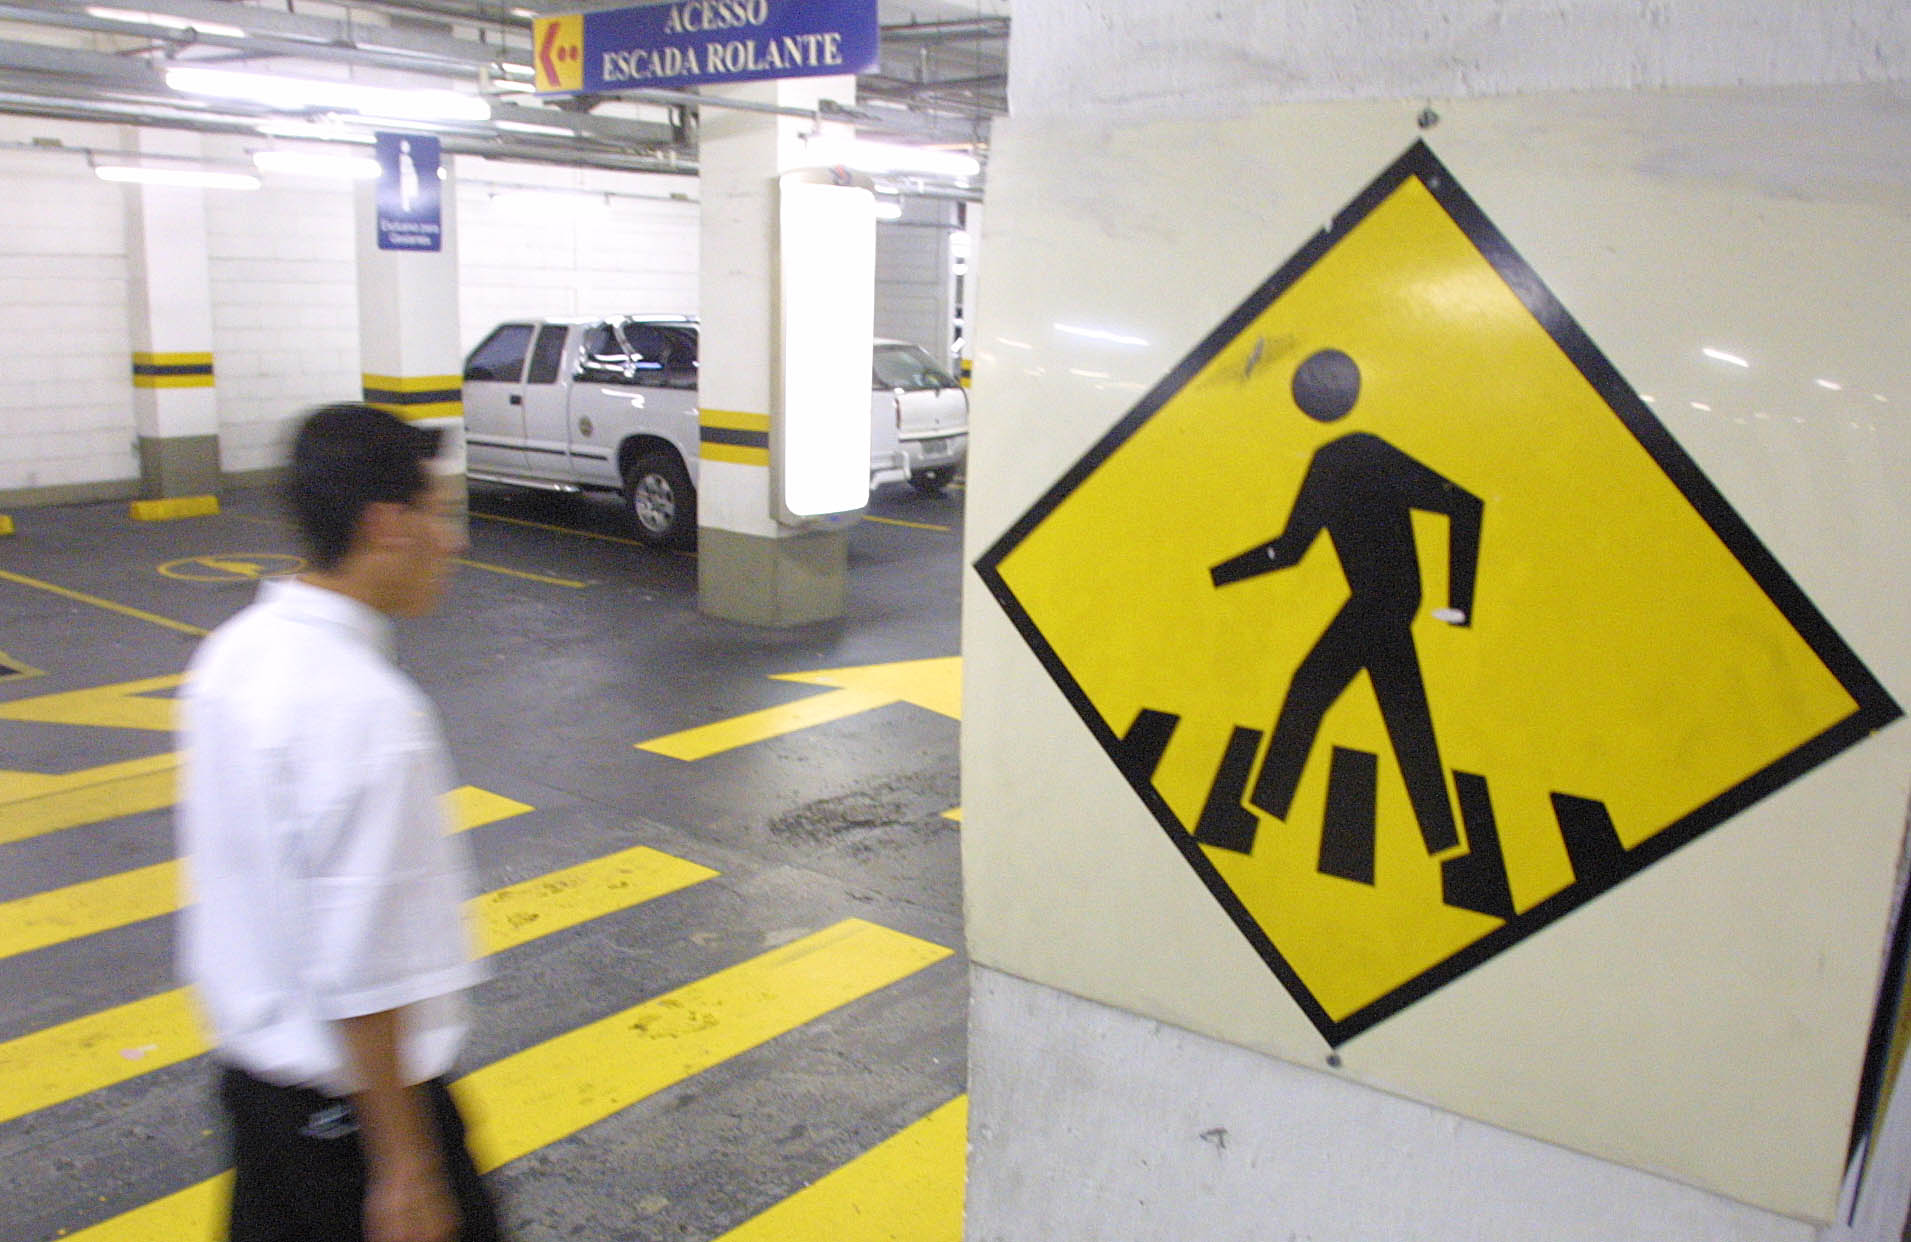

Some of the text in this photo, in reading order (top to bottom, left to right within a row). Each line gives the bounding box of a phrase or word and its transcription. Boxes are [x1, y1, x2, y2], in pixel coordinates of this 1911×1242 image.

[665, 0, 768, 33] ACESSO
[602, 32, 843, 82] ESCADA ROLANTE
